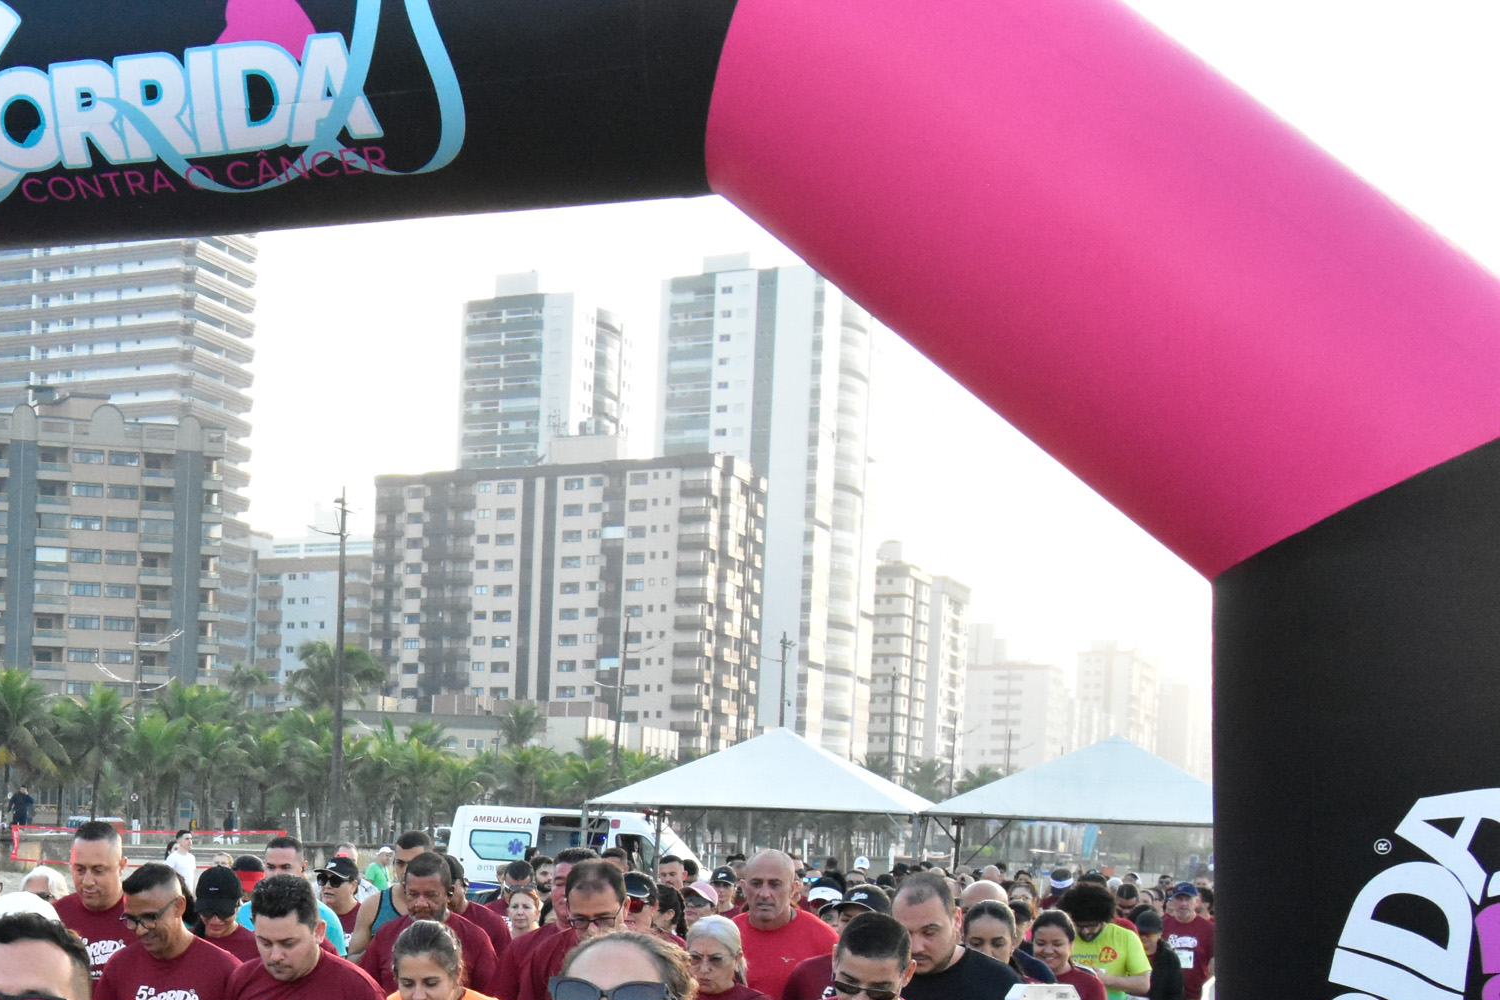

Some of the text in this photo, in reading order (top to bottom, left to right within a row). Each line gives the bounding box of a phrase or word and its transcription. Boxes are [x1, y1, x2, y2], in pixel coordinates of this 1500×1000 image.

[21, 146, 391, 203] CONTRA O CÂNCER
[472, 815, 532, 824] AMBULÂNCIA
